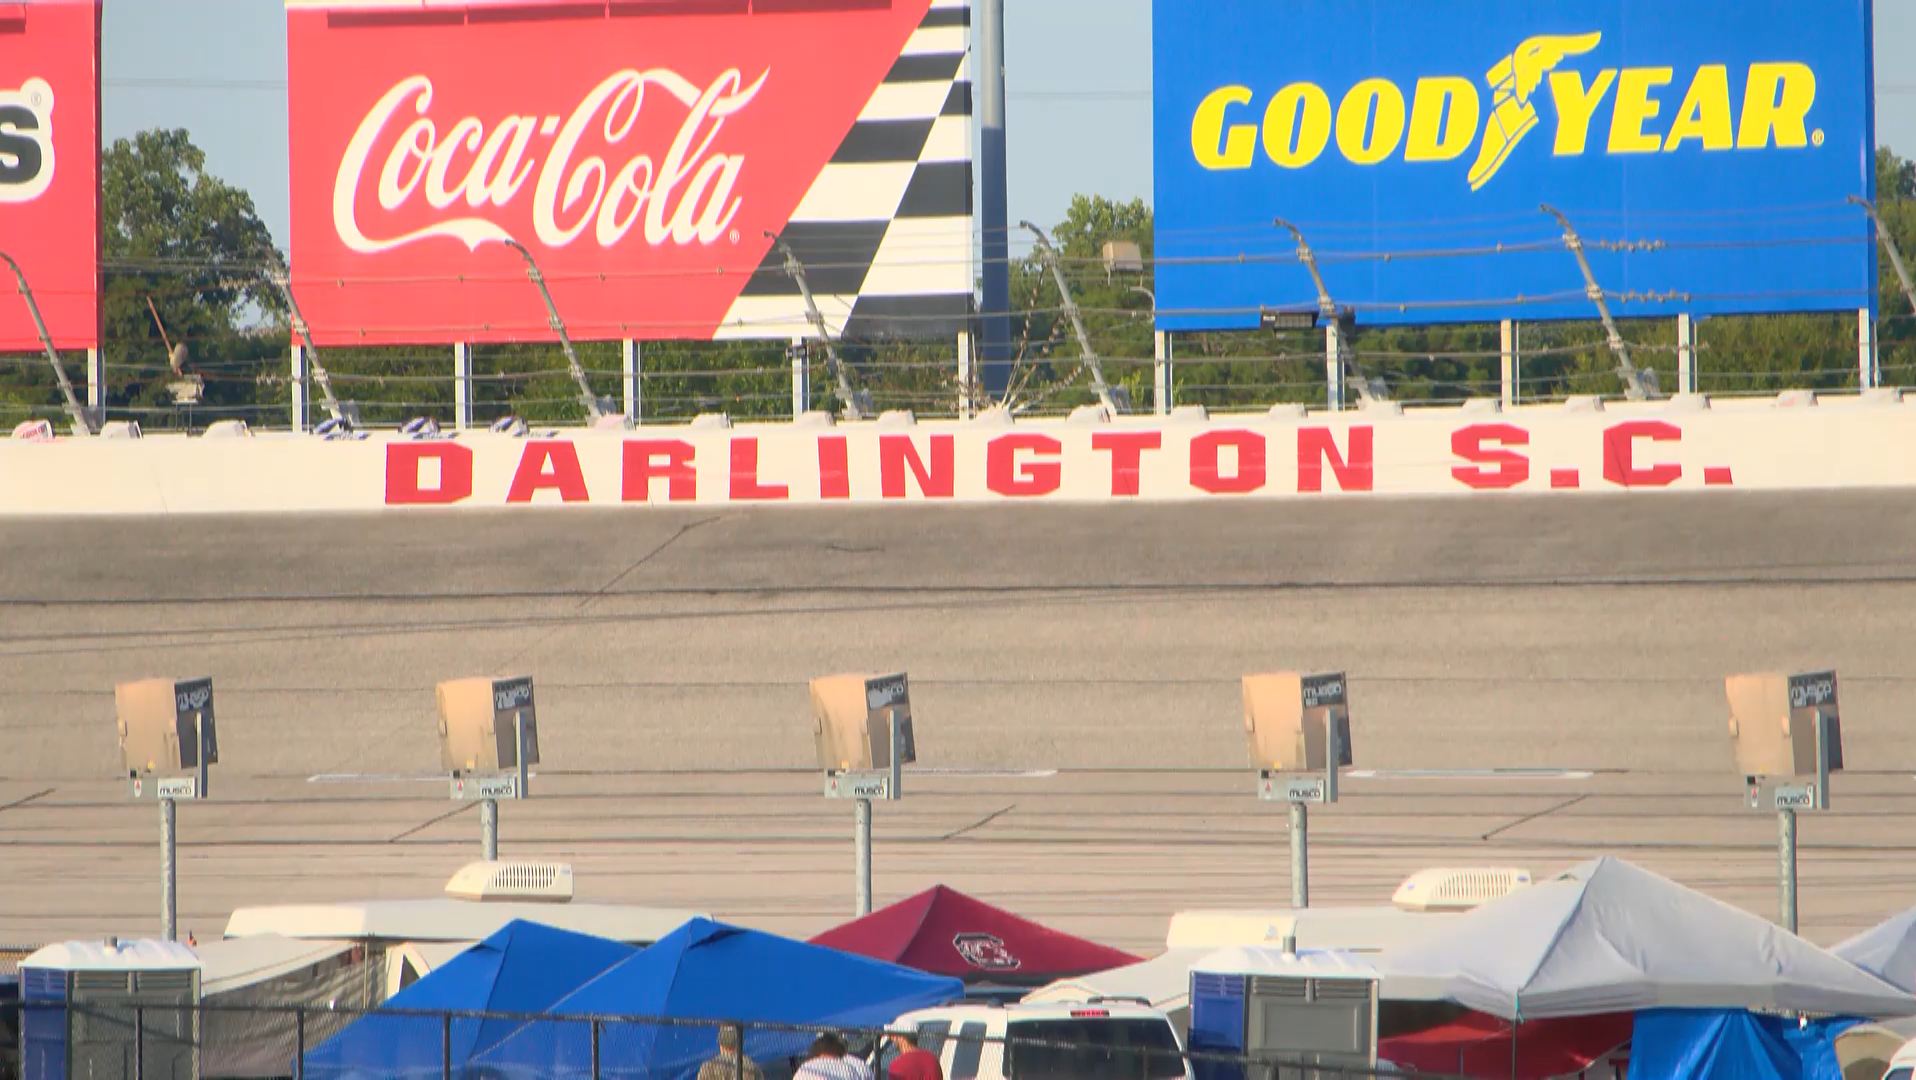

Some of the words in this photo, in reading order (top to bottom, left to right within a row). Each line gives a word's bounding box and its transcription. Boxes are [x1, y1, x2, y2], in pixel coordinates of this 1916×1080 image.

[333, 66, 770, 254] Coca-Cola
[385, 425, 1374, 505] DARLINGTON
[1451, 420, 1733, 489] S.C.
